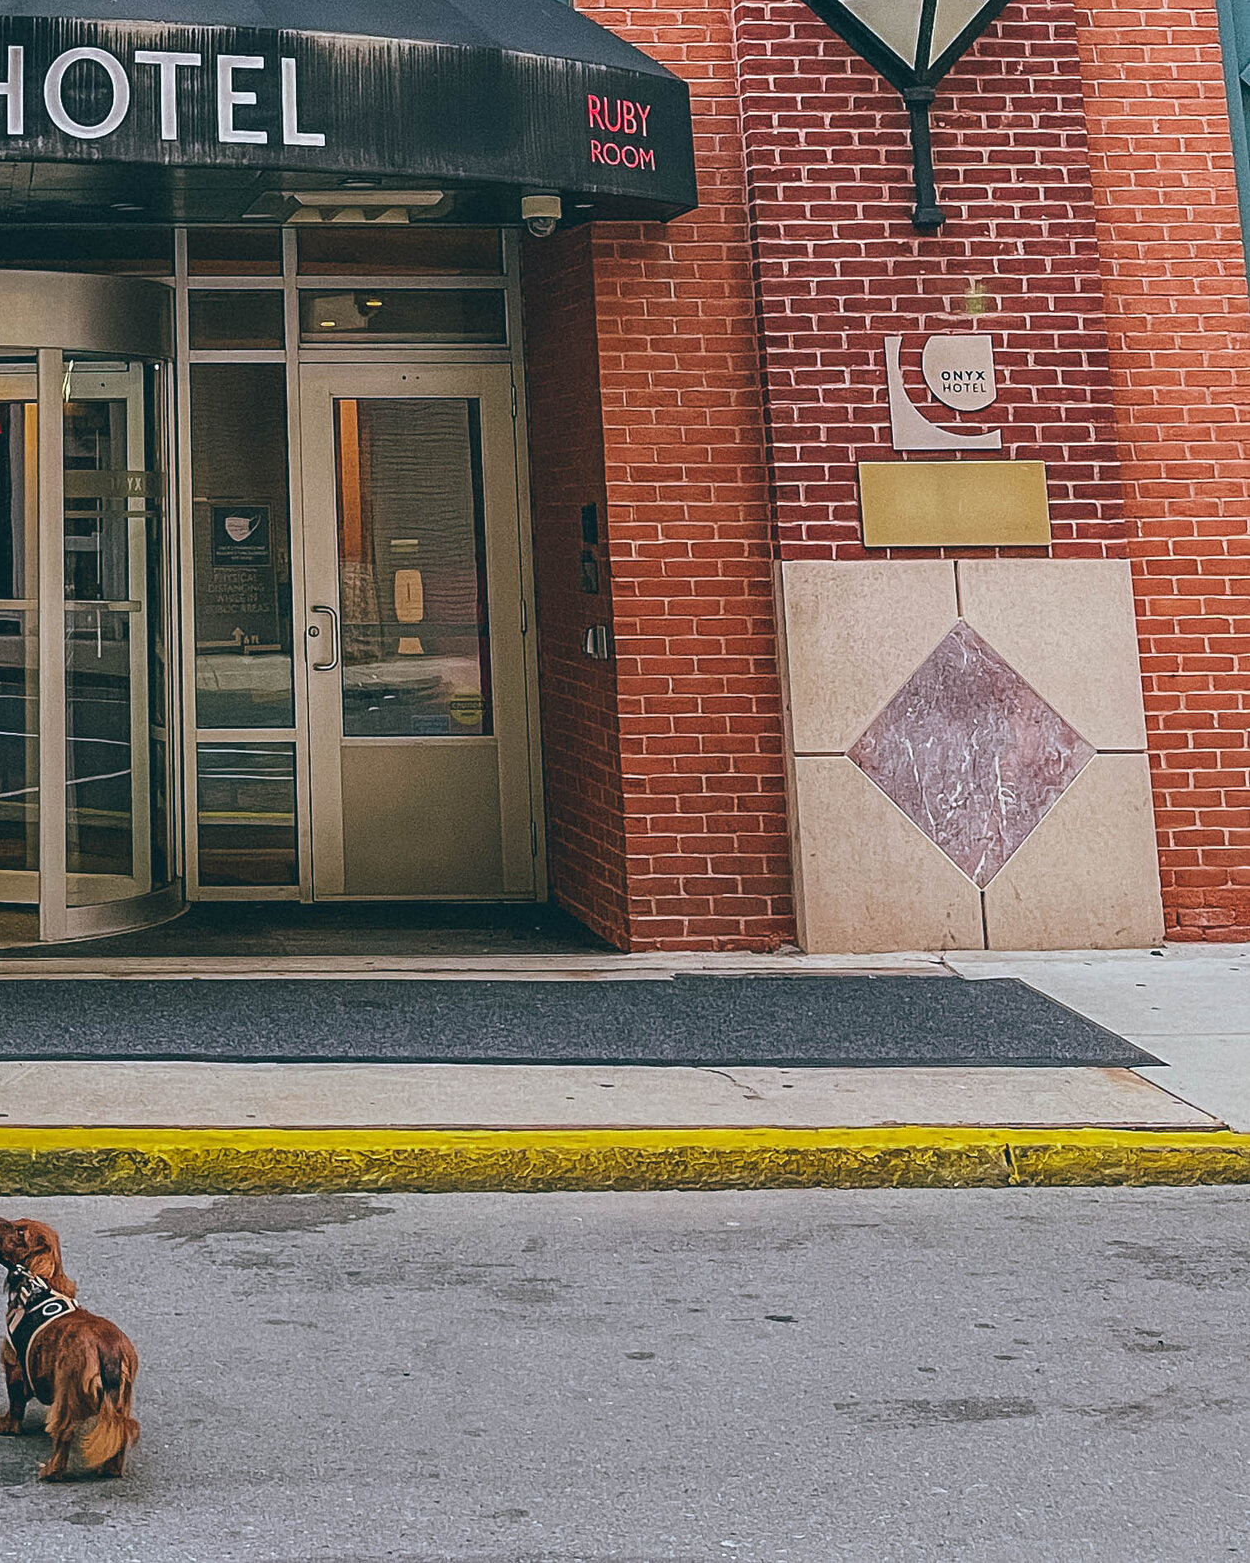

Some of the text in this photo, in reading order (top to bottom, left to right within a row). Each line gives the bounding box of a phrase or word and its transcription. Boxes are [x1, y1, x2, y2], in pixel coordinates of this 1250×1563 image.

[587, 94, 651, 137] RUBY
[590, 139, 655, 171] ROOM
[941, 370, 986, 381] ONYX
[942, 383, 987, 393] HOTEL
